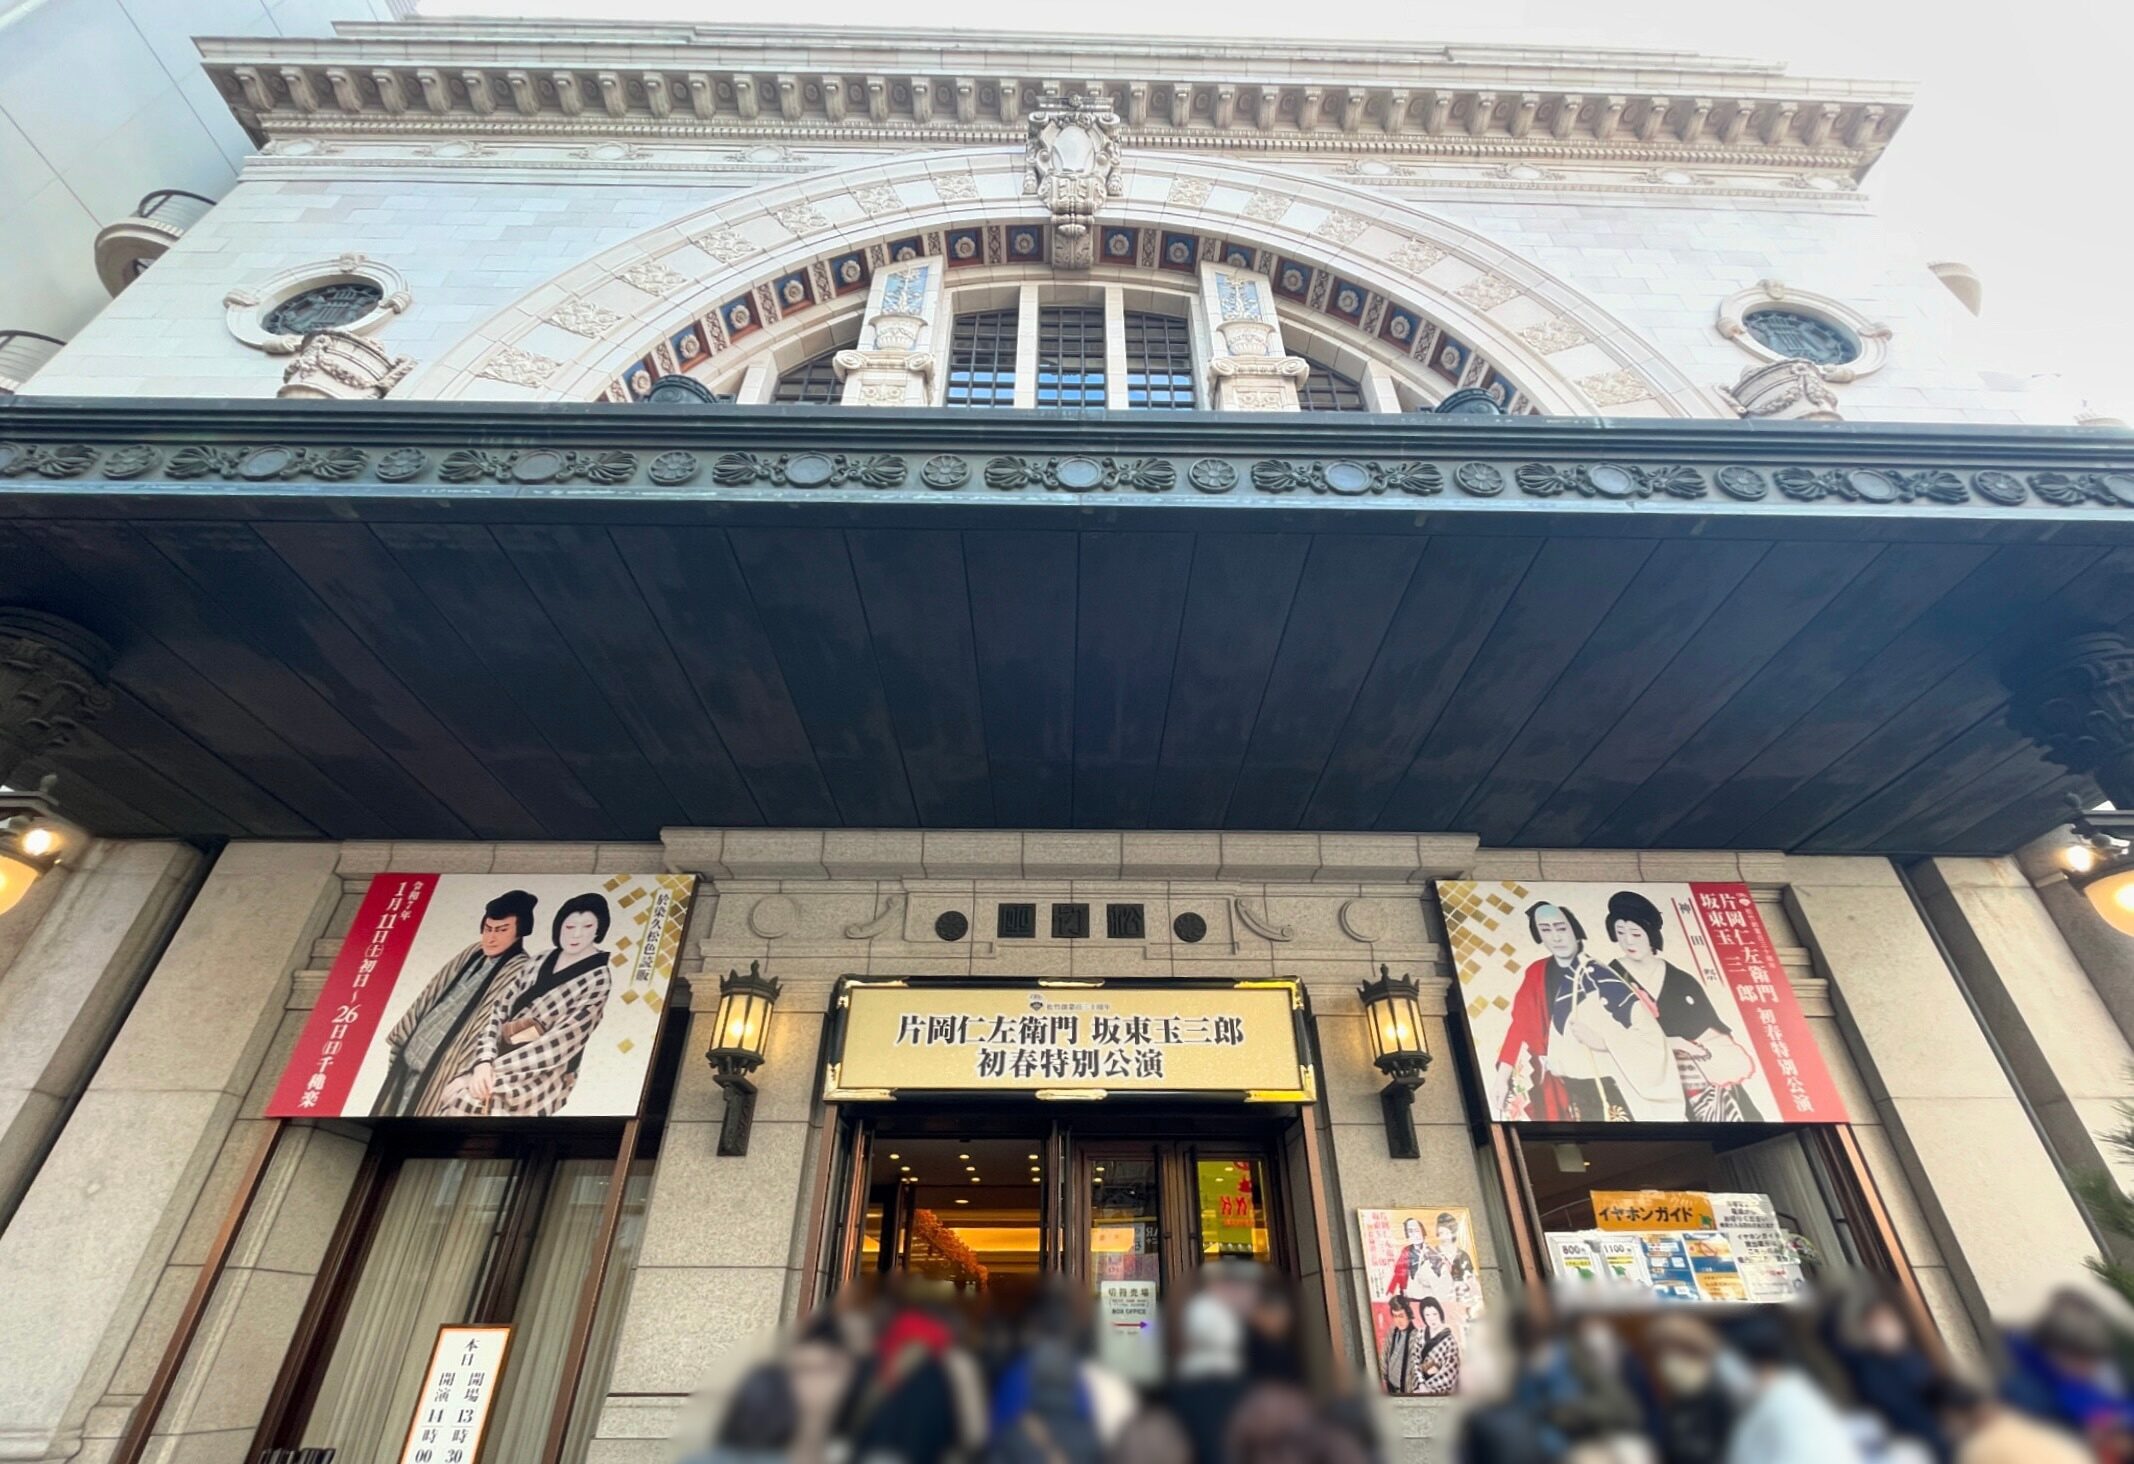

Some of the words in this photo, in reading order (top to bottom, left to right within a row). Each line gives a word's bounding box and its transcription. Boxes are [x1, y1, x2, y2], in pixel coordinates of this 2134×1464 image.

[400, 880, 424, 921] 令和7年
[1700, 892, 1757, 1003] 坂東玉三郎
[1720, 893, 1778, 1003] 片岡仁左衛門
[896, 1015, 1078, 1045] 片岡仁左衛門
[1091, 1015, 1244, 1046] 坂東玉三郎
[977, 1047, 1165, 1079] 初春特別公演
[1756, 1008, 1815, 1113] 初春特別公演
[1598, 1207, 1693, 1223] イヤホンガイド
[460, 1338, 479, 1367] 本日
